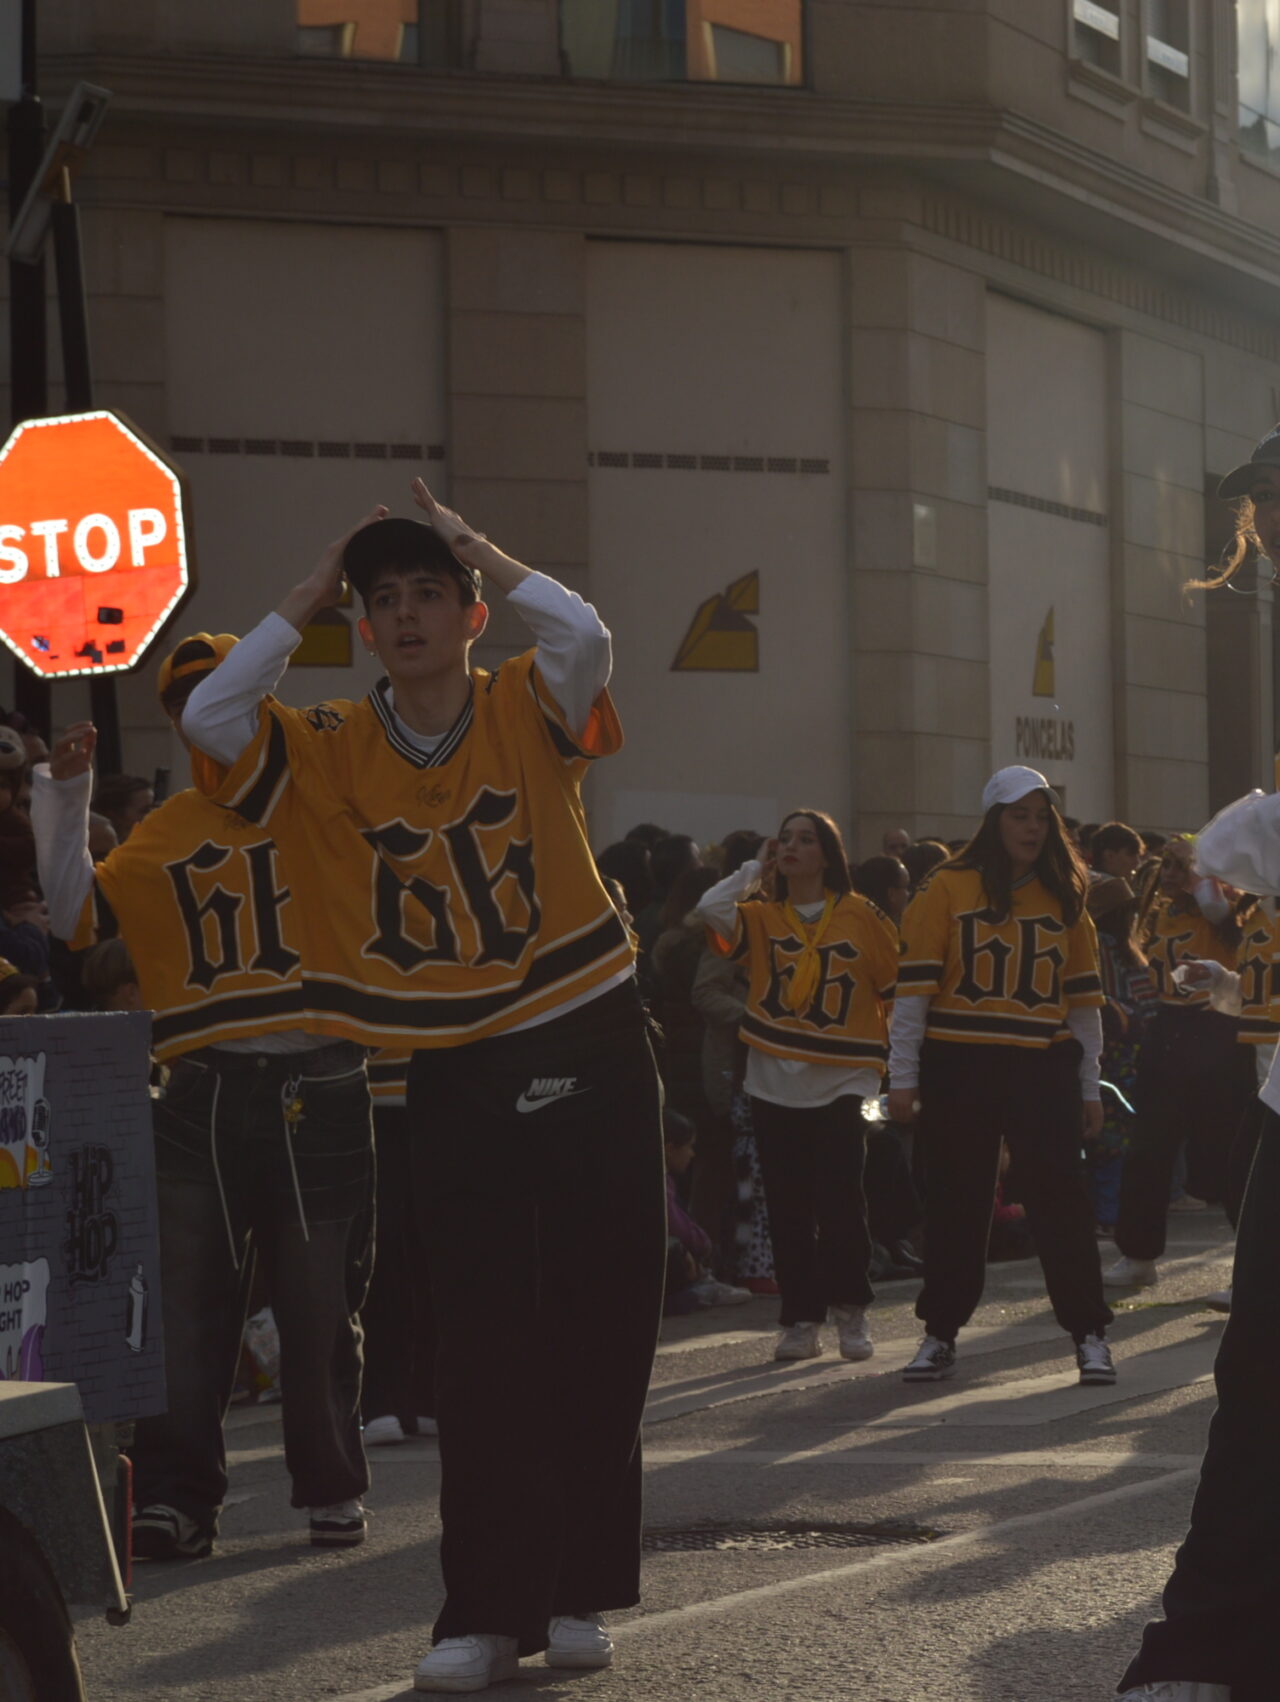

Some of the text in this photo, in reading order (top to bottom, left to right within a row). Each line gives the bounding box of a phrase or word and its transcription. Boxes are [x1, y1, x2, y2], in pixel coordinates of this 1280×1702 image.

[0, 507, 167, 585] STOP
[1015, 715, 1075, 762] PONCELAS
[358, 785, 542, 976] 66
[952, 908, 1067, 1011] 66
[526, 1077, 577, 1097] NIKE
[4, 1280, 31, 1301] HOP
